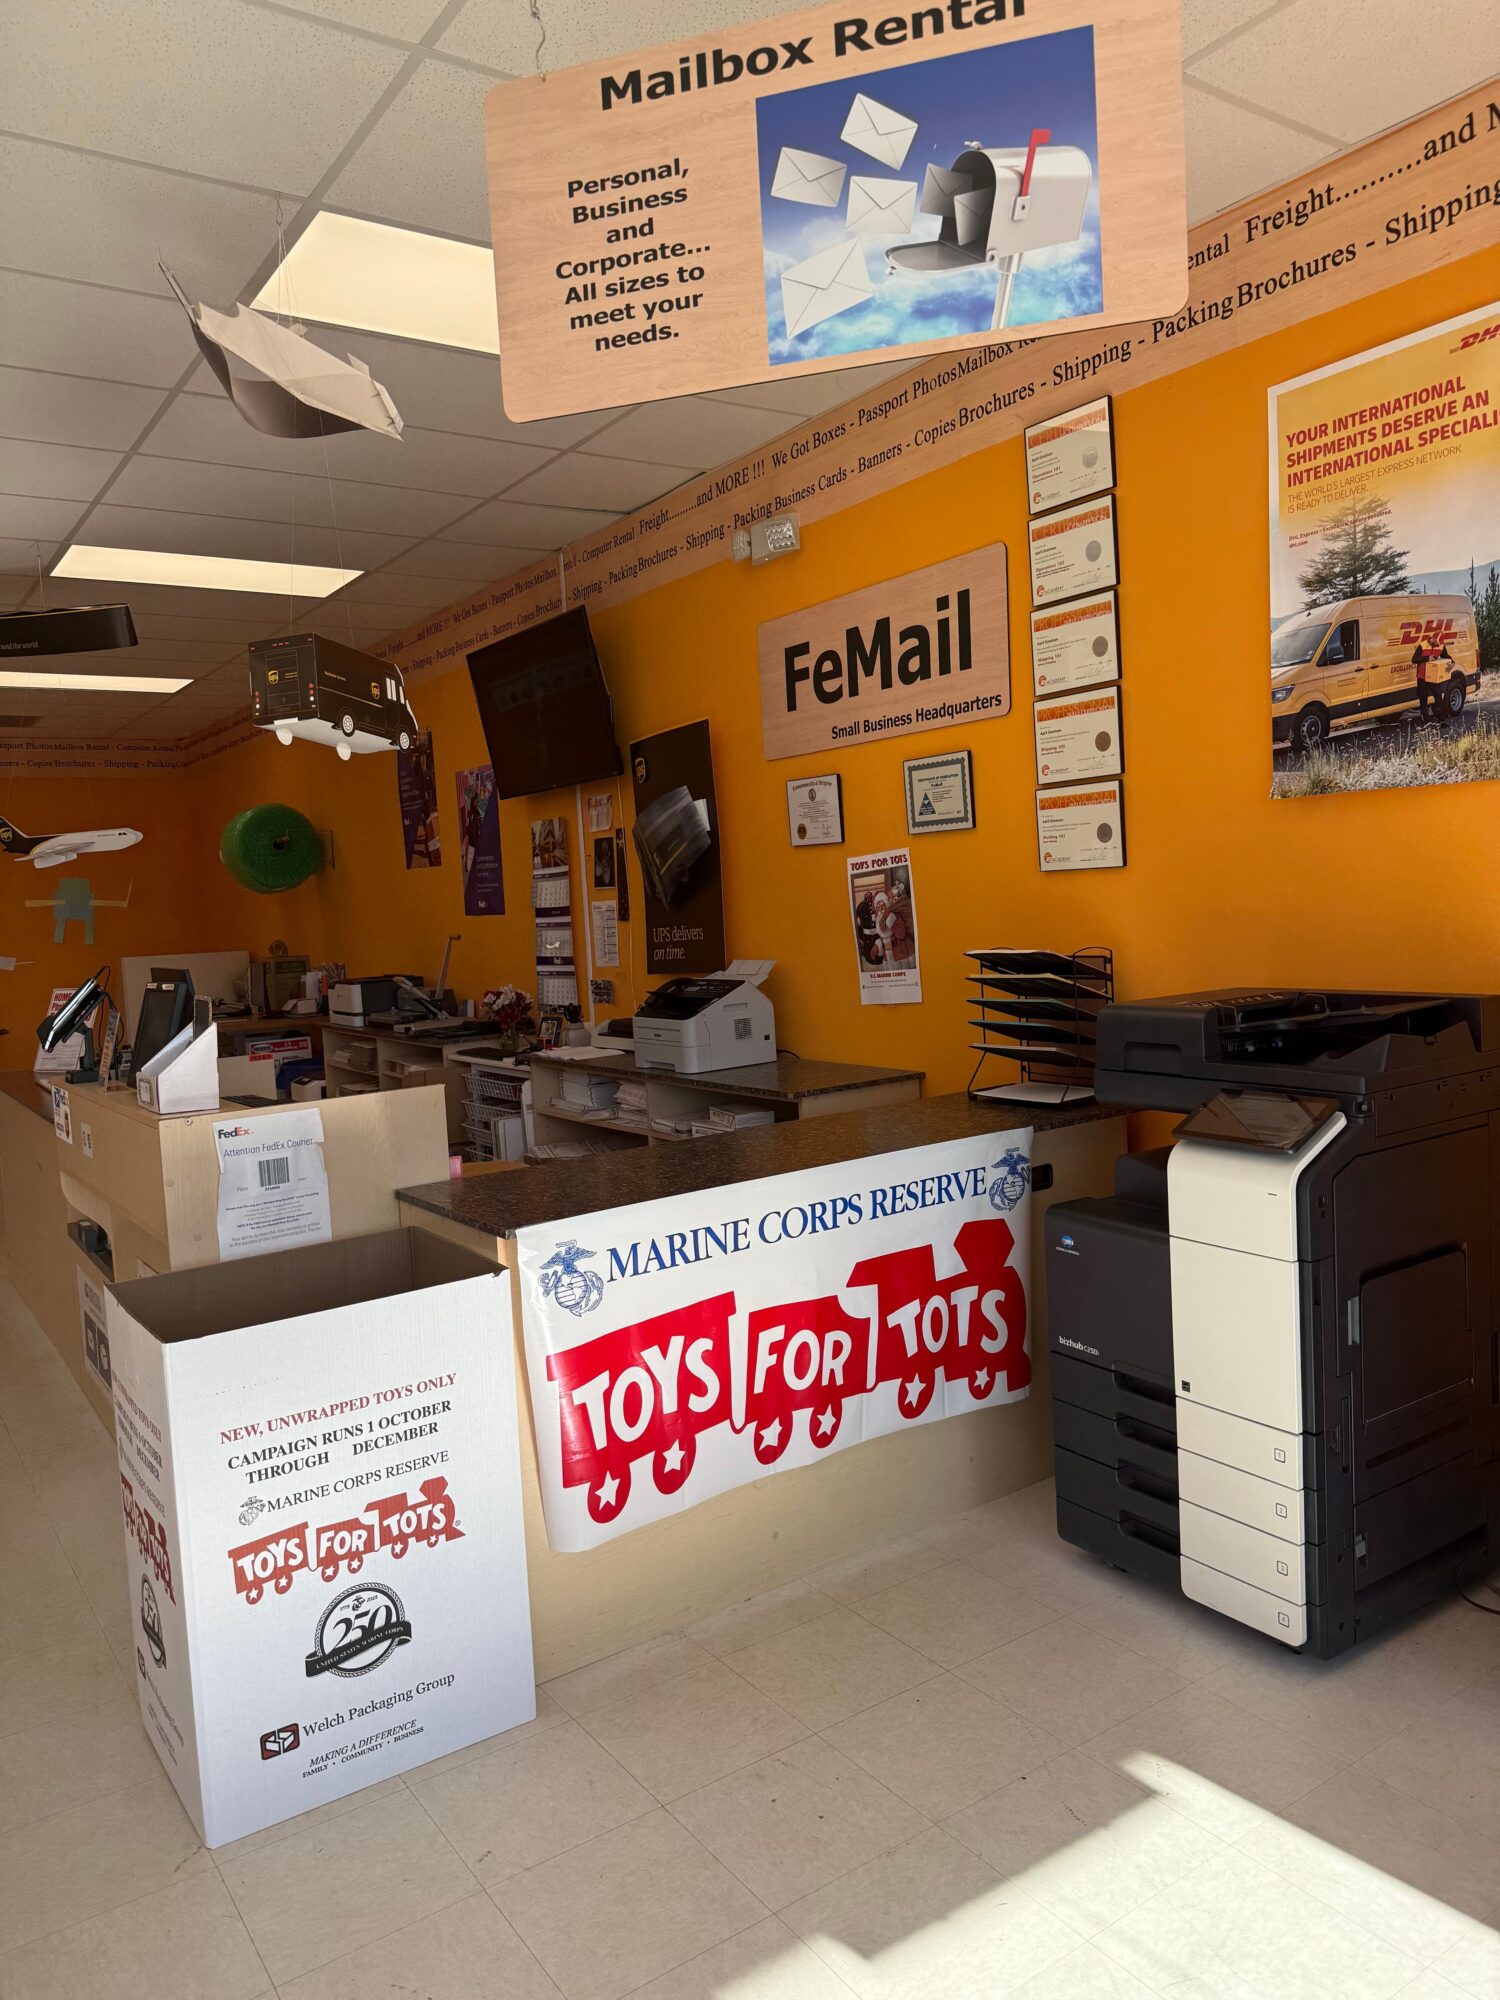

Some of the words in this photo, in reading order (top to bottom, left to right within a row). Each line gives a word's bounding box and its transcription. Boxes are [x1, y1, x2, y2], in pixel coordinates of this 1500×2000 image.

[600, 35, 813, 111] Mailbox
[567, 157, 689, 198] Personal,
[572, 187, 688, 224] Business
[606, 217, 655, 244] and
[1187, 233, 1229, 270] ental
[555, 242, 711, 280] Corporate...
[564, 279, 597, 304] All
[605, 272, 668, 298] sizes
[681, 263, 705, 285] to
[570, 302, 635, 330] meet
[643, 291, 703, 325] your
[594, 323, 680, 352] needs.
[1458, 325, 1500, 350] DH
[1286, 423, 1328, 448] YOUR
[1332, 376, 1466, 435] INTERNATIONAL
[1286, 427, 1377, 468] SHIPMENTS
[1381, 400, 1457, 439] DESERVE
[1462, 390, 1490, 413] AN
[572, 580, 602, 601] Shipping
[686, 524, 725, 550] Shipping
[733, 502, 773, 529] Packing
[774, 486, 815, 511] Business
[818, 467, 847, 491] Cards
[858, 444, 903, 473] Banners
[914, 418, 956, 447] Copies
[959, 381, 1035, 427] Brochures
[1053, 340, 1132, 386] Shipping
[1287, 437, 1414, 488] INTERNATIONAL
[1418, 409, 1500, 448] SPECIALI
[582, 539, 613, 562] Computer
[613, 528, 635, 548] Rental
[715, 467, 749, 496] MORE
[771, 451, 788, 468] We
[790, 441, 810, 461] Got
[812, 422, 846, 449] Boxes
[857, 391, 909, 427] Passport
[1288, 492, 1303, 503] THE
[1304, 481, 1338, 499] WORLD'S
[1340, 470, 1376, 493] LARGEST
[1377, 459, 1415, 477] EXPRESS
[1415, 444, 1462, 466] NETWORK
[1287, 505, 1295, 513] IS
[1296, 498, 1322, 512] READY
[1323, 494, 1333, 505] TO
[784, 588, 972, 713] FeMail
[1399, 619, 1458, 646] DHL
[831, 722, 860, 739] Small
[863, 711, 912, 734] Business
[915, 694, 1002, 723] Headquarters
[850, 859, 869, 871] TOYS
[872, 857, 888, 869] FOR
[890, 854, 908, 864] TOTS
[653, 926, 670, 943] UPS
[671, 926, 704, 942] delivers
[653, 947, 665, 960] on
[666, 945, 686, 960] time.
[218, 1126, 250, 1139] FedEx
[224, 1145, 260, 1158] Attention
[262, 1141, 285, 1152] FedEx
[287, 1137, 313, 1149] Courier
[607, 1218, 750, 1282] MARINE
[758, 1193, 864, 1244] CORPS
[869, 1167, 986, 1220] RESERVE
[1059, 1335, 1083, 1351] bizhub
[572, 1335, 720, 1451] TOYS
[754, 1324, 852, 1394] FOR
[887, 1285, 1008, 1358] TOTS
[220, 1423, 264, 1444] NEW,
[267, 1396, 370, 1432] UNWRAPPED
[373, 1384, 414, 1405] TOYS
[416, 1372, 457, 1394] ONLY
[227, 1435, 318, 1470] CAMPAIGN
[321, 1423, 364, 1446] RUNS
[367, 1421, 374, 1433] 1
[378, 1400, 452, 1429] OCTOBER
[245, 1452, 330, 1484] THROUGH
[352, 1422, 439, 1456] DECEMBER
[267, 1484, 331, 1512] MARINE
[333, 1469, 382, 1493] CORPS
[385, 1450, 450, 1479] RESERVE
[237, 1538, 304, 1582] TOYS
[319, 1529, 368, 1558] FOR
[382, 1503, 446, 1536] TOTS
[316, 1655, 339, 1670] UNITED
[340, 1644, 361, 1658] STATES
[361, 1633, 384, 1647] MARINE
[385, 1626, 404, 1636] CORPS
[333, 1604, 393, 1650] 250
[302, 1713, 345, 1737] Welch
[348, 1689, 414, 1722] Packaging
[416, 1673, 455, 1696] Group
[302, 1763, 328, 1778] FAMILY
[341, 1743, 384, 1763] COMMUNITY
[393, 1726, 424, 1743] BUSINESS
[309, 1745, 349, 1767] MAKING
[350, 1743, 357, 1752] A
[358, 1720, 417, 1749] DIFFERENCE
